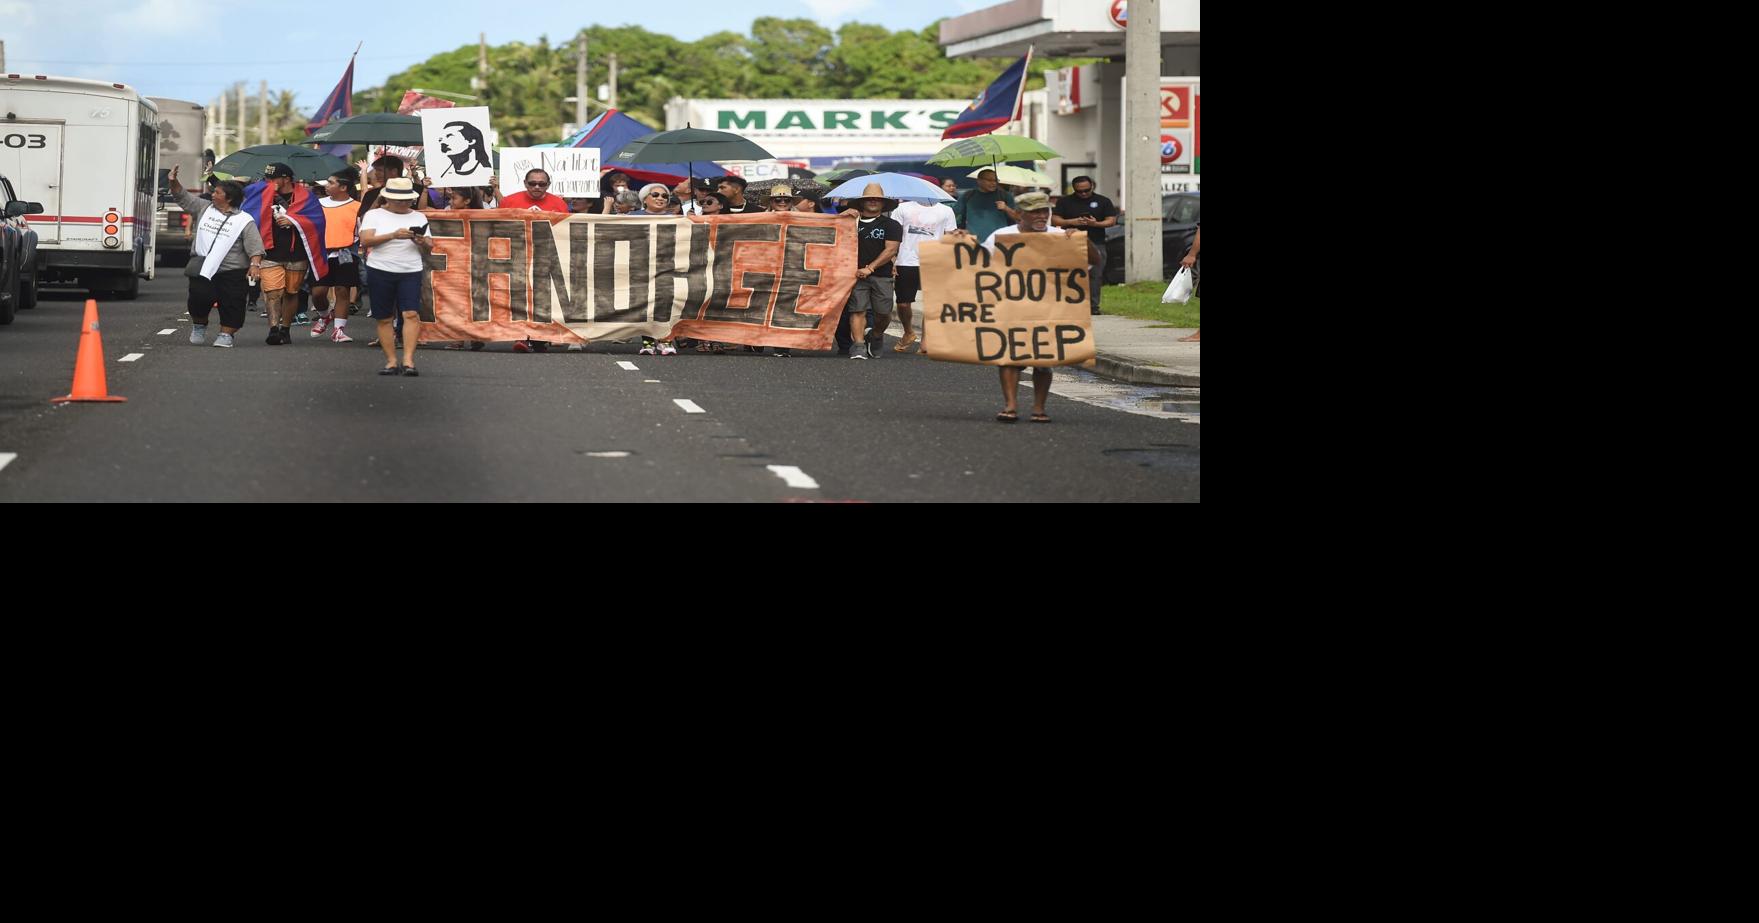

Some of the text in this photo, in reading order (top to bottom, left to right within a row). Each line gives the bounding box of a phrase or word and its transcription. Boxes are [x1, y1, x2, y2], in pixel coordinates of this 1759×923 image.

[717, 110, 960, 129] MARK'S
[954, 242, 1026, 270] MY
[418, 218, 838, 330] FANOHGE
[975, 267, 1087, 304] ROOTS
[940, 302, 996, 324] ARE
[975, 324, 1086, 362] DEEP
